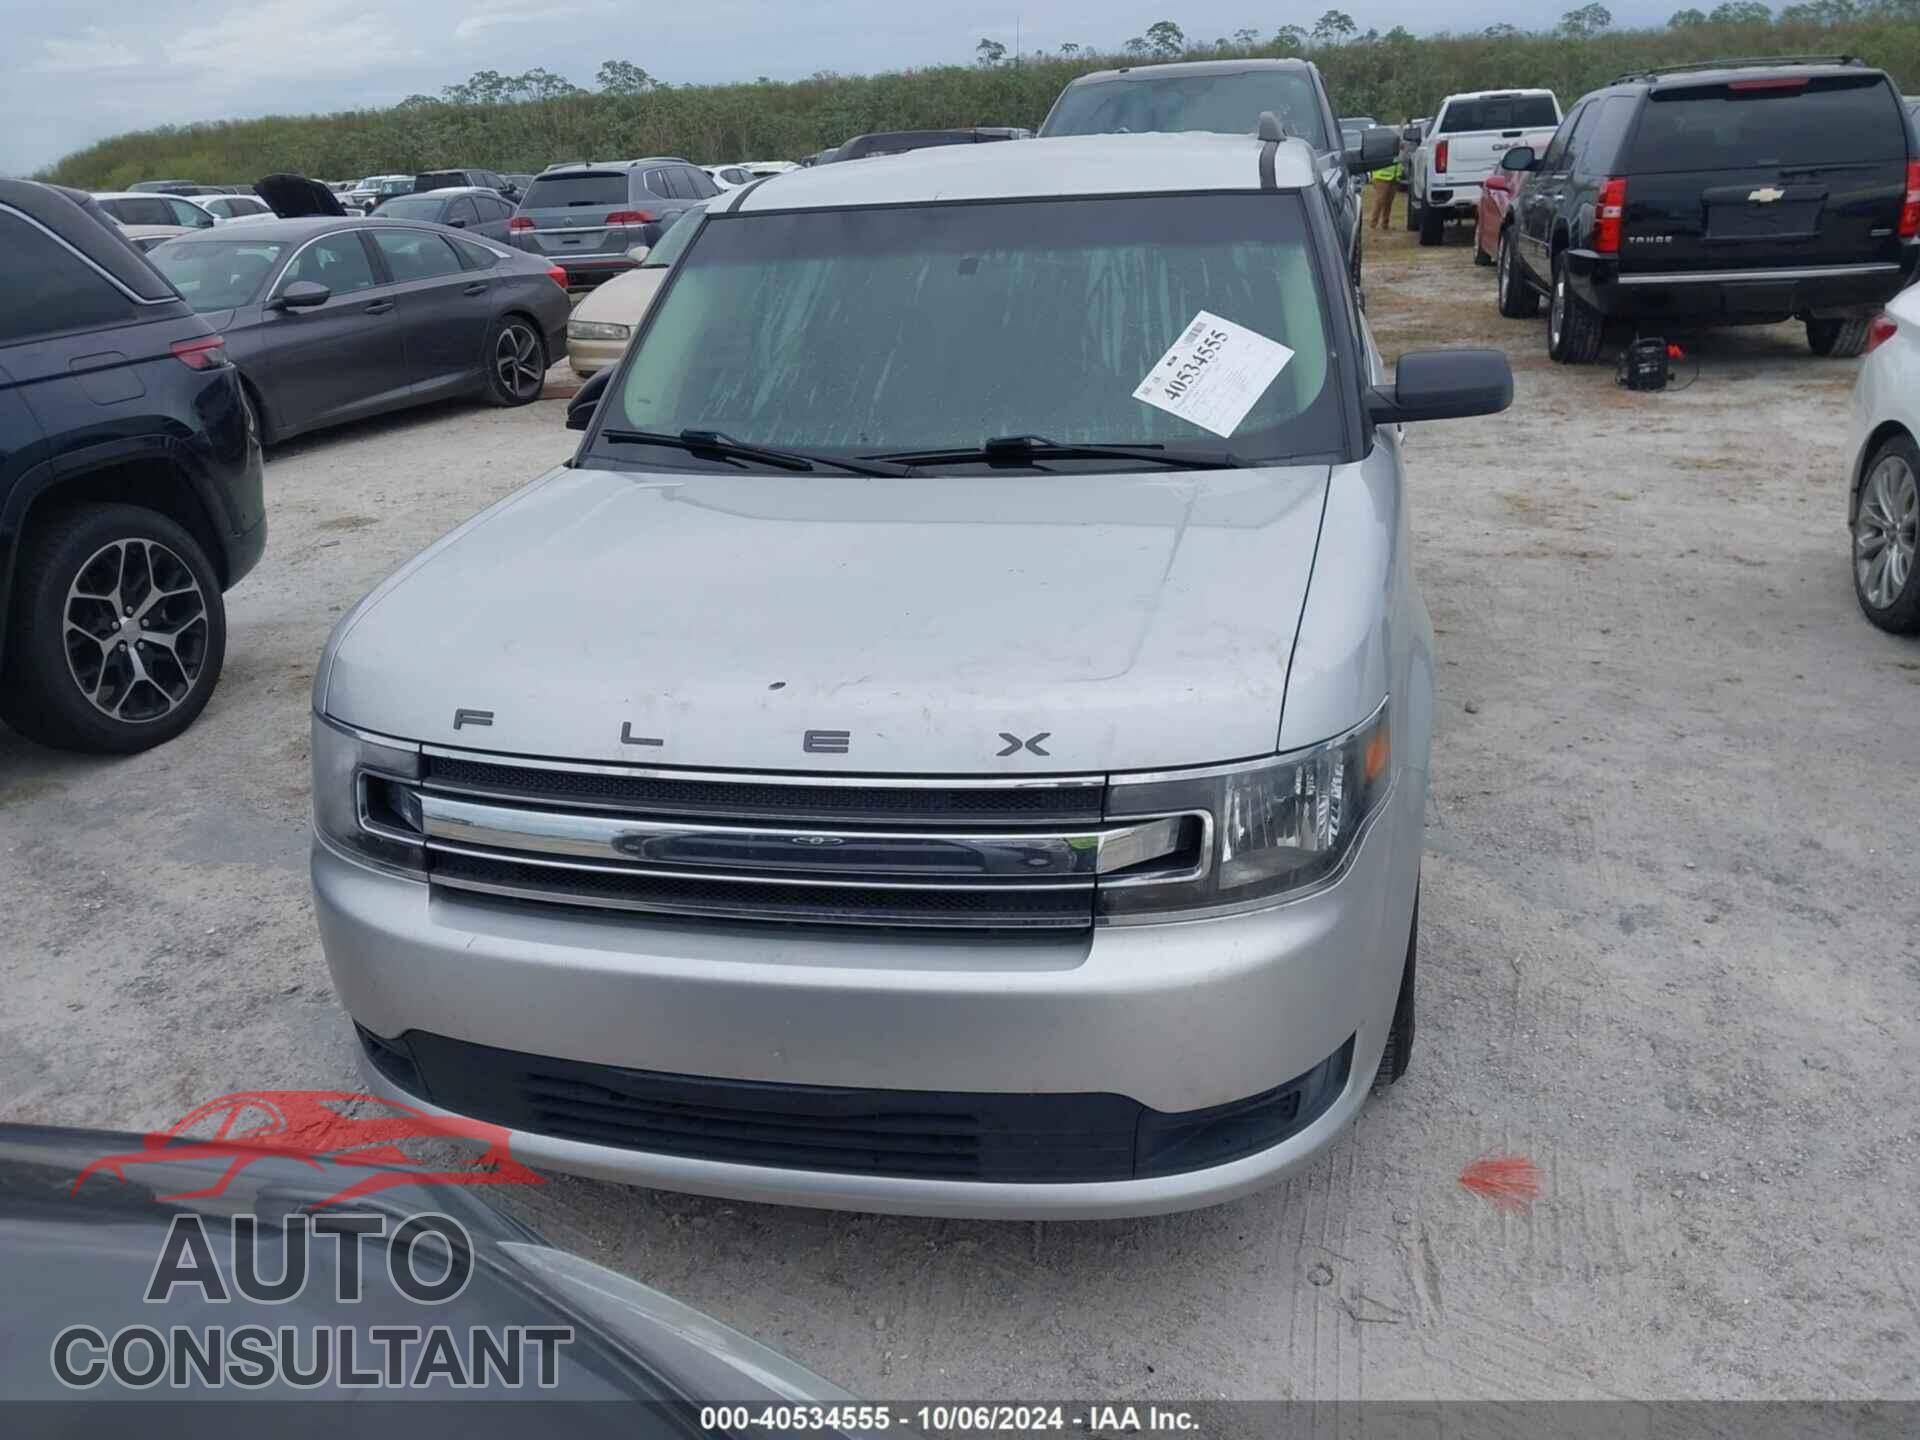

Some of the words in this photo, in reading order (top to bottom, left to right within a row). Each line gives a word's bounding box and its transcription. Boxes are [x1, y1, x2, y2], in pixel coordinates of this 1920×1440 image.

[1628, 235, 1673, 244] TAHOE
[1164, 329, 1229, 400] 40534555
[453, 708, 1051, 757] FLEX
